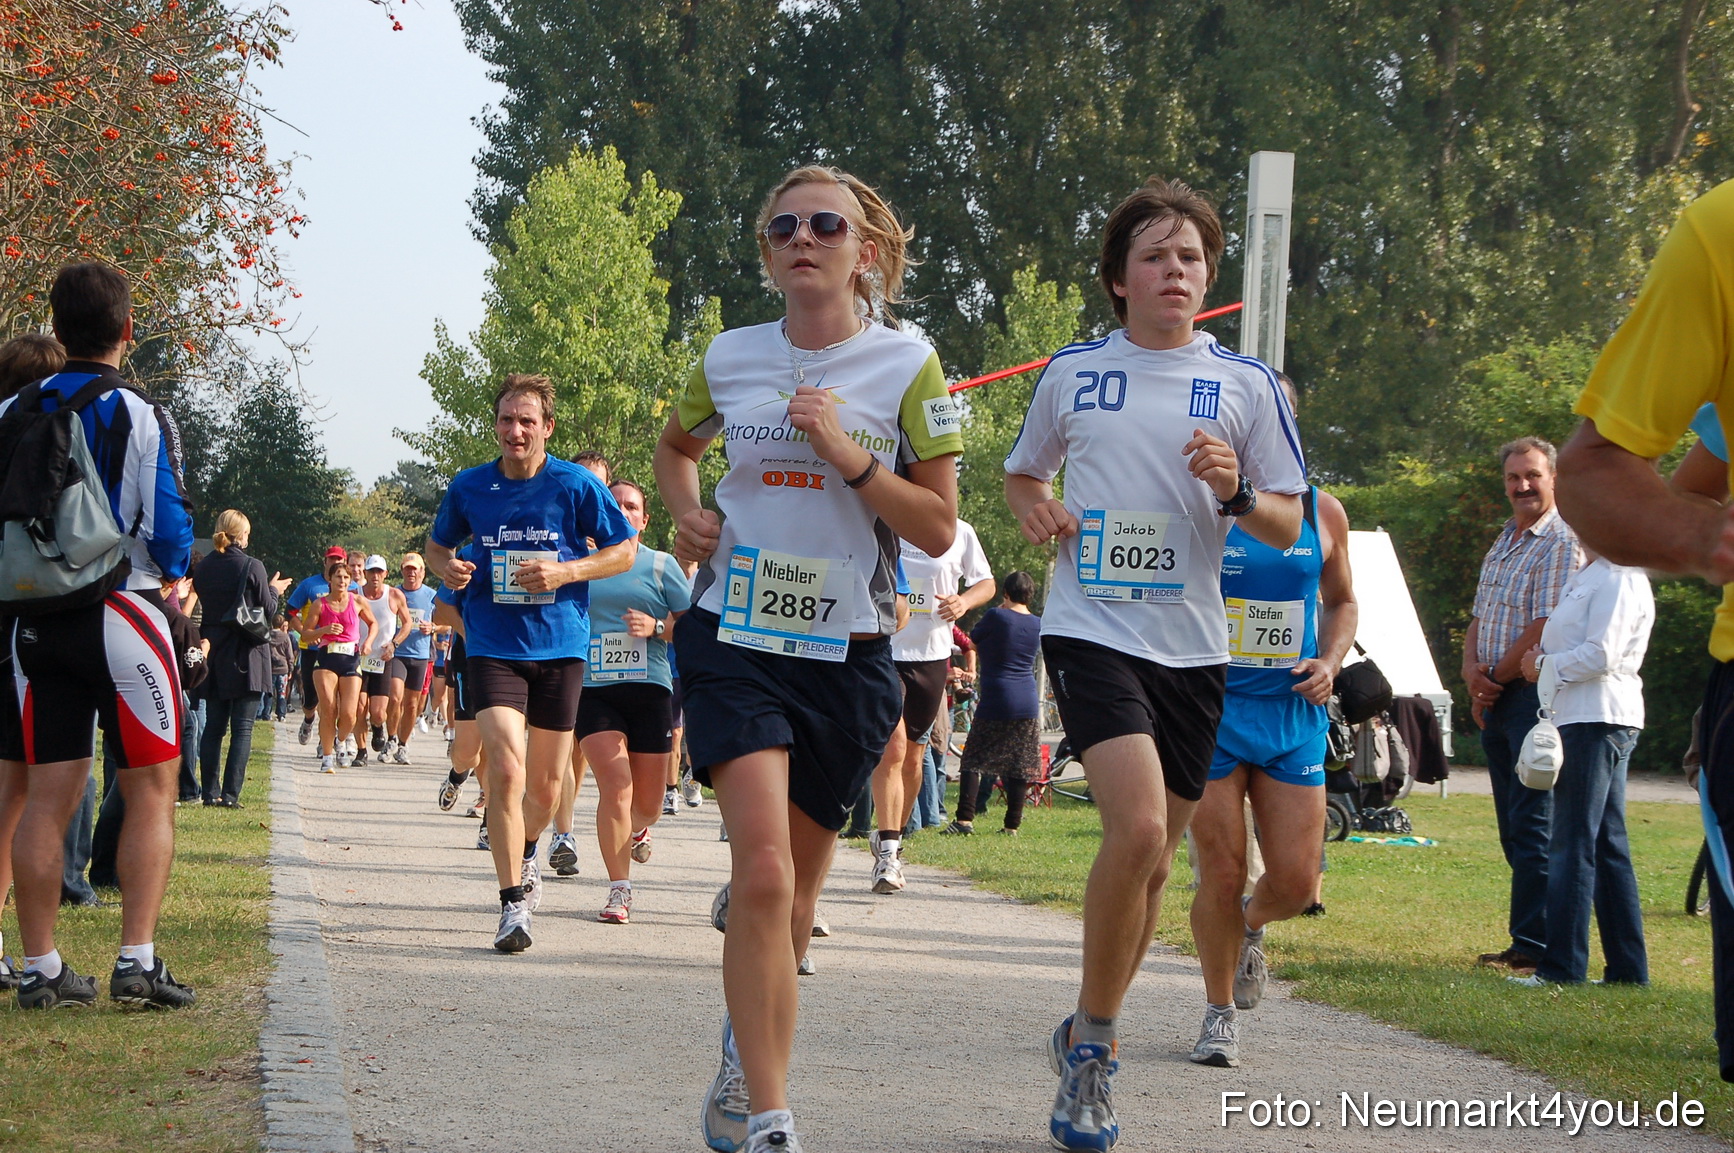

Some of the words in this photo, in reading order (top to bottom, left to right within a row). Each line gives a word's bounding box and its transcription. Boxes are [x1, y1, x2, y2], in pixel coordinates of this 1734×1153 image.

[1073, 370, 1128, 412] 20
[761, 470, 826, 491] OBI
[1114, 522, 1156, 536] Jakob
[1081, 545, 1090, 558] C
[1109, 545, 1176, 571] 6023
[762, 558, 817, 584] Niebler
[733, 582, 741, 596] C
[760, 589, 838, 623] 2887
[1248, 605, 1283, 620] Stefan
[604, 638, 622, 647] Anita
[1255, 627, 1293, 646] 766
[797, 641, 846, 656] PFLEIDERER
[367, 659, 381, 667] 926
[605, 650, 640, 664] 2279
[136, 662, 170, 731] Giordana
